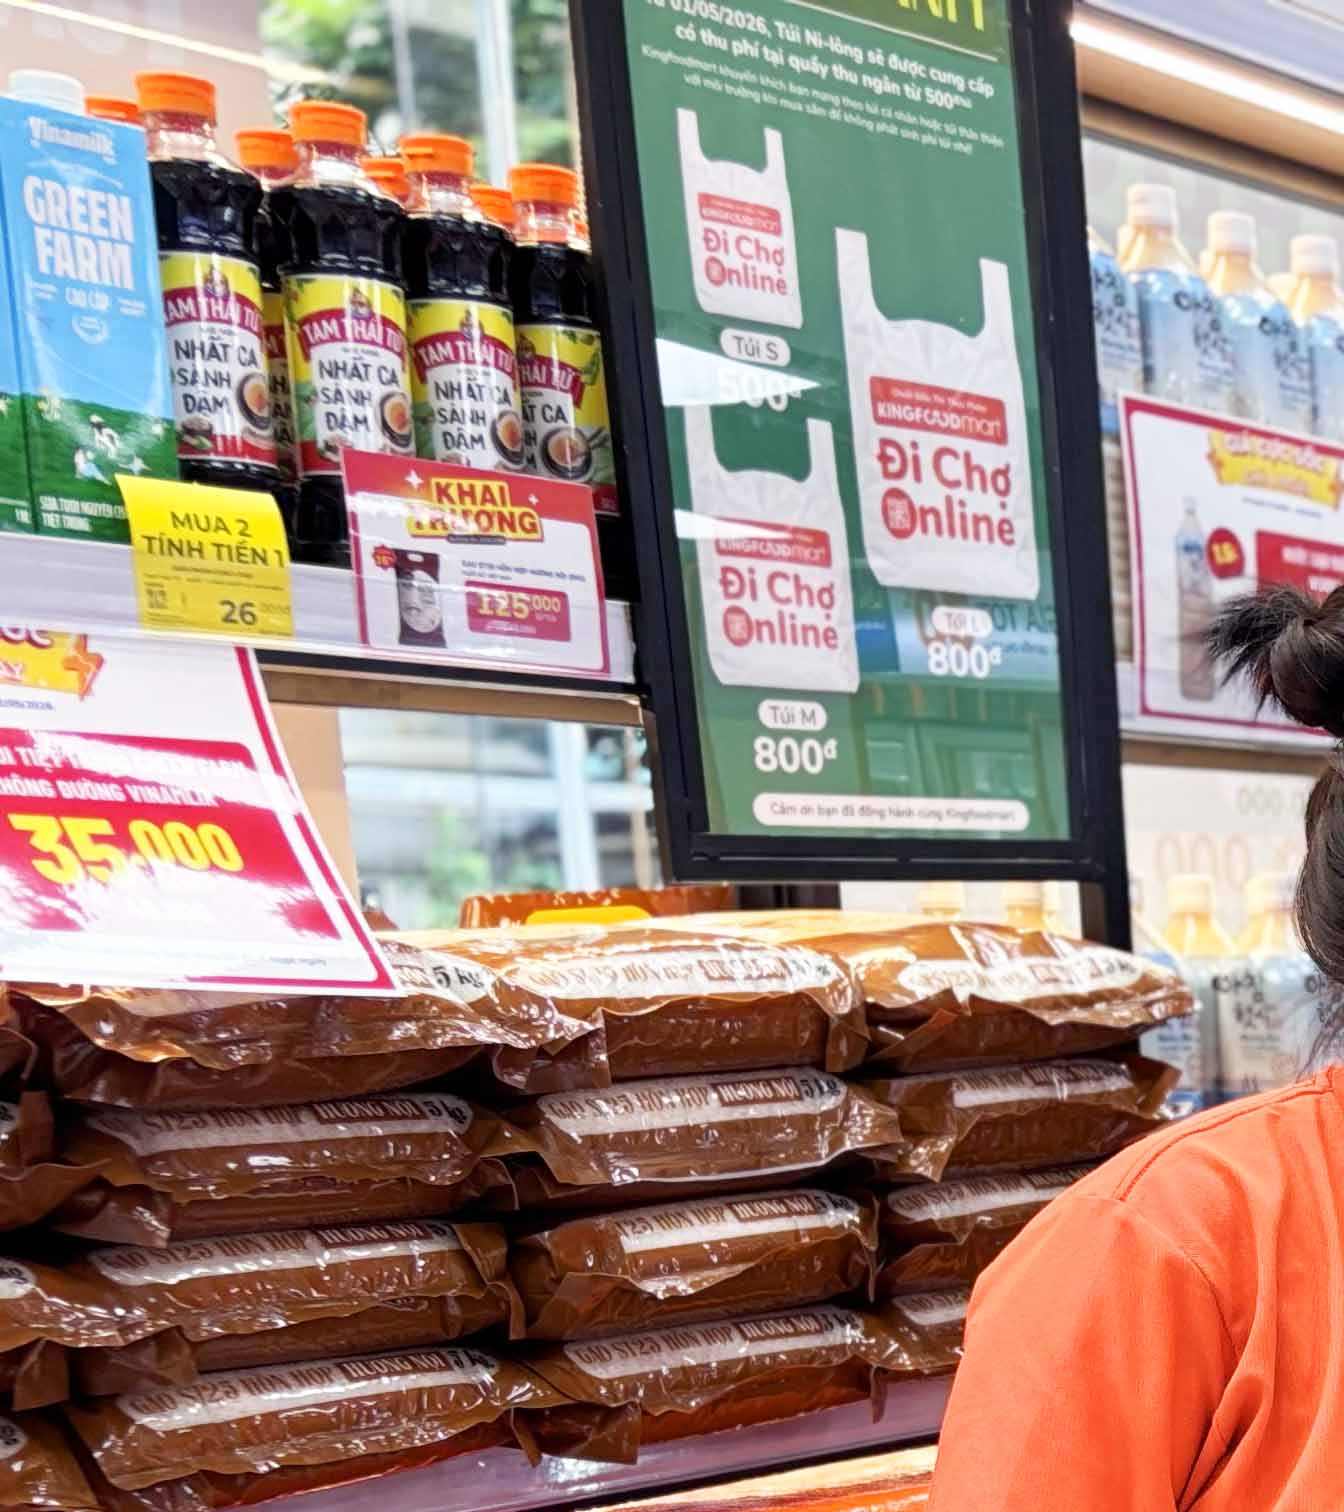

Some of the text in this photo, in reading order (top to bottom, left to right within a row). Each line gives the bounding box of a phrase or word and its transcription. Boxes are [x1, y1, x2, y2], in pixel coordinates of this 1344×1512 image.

[675, 21, 696, 42] có
[700, 28, 728, 50] thu
[731, 38, 760, 59] phí
[762, 45, 784, 68] tại
[832, 63, 858, 86] thu
[773, 20, 801, 43] Túi
[888, 53, 927, 78] được
[928, 67, 964, 92] cung
[968, 75, 995, 99] cấp
[24, 176, 135, 245] GREEN
[34, 226, 135, 290] FARM
[703, 227, 785, 275] Đi Chợ
[705, 256, 788, 296] Online
[303, 321, 337, 344] TAM
[733, 335, 779, 361] Túi S
[174, 335, 258, 369] NHẤT CA
[420, 342, 455, 367] TAM
[319, 356, 399, 386] NHẤT CA
[435, 377, 487, 400] NHẤT
[541, 404, 569, 425] CA
[877, 437, 1011, 510] Đi Chợ
[434, 481, 507, 507] KHAI
[170, 510, 251, 537] MUA 2
[881, 487, 1015, 546] Online
[142, 535, 204, 560] TÍNH
[275, 550, 284, 568] 1
[719, 566, 835, 620] Đi Chợ
[220, 600, 257, 625] 26
[723, 605, 838, 649] Online
[769, 706, 816, 725] Túi M
[753, 736, 837, 774] 800đ
[434, 964, 485, 990] 5 kg
